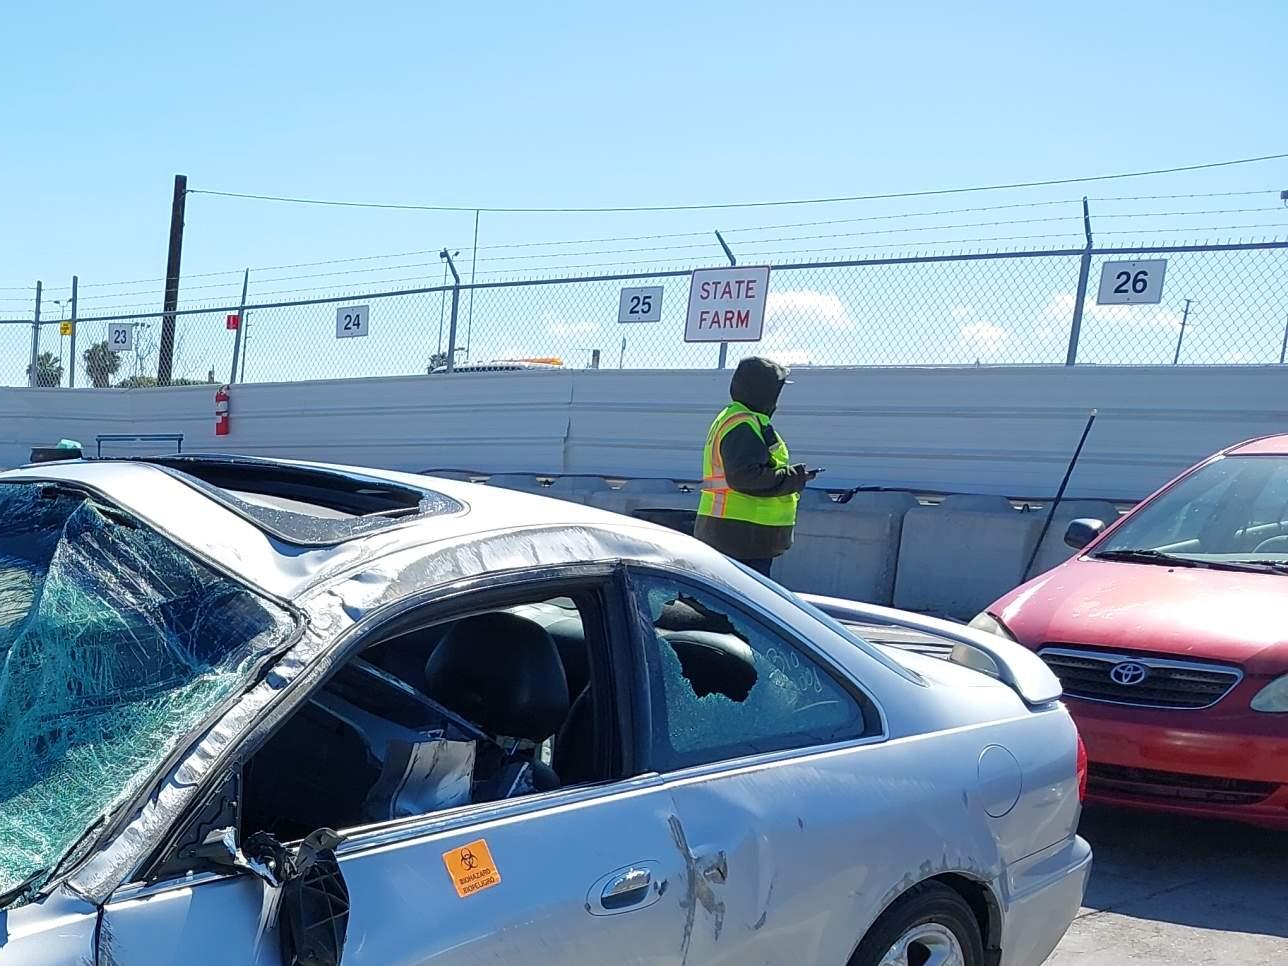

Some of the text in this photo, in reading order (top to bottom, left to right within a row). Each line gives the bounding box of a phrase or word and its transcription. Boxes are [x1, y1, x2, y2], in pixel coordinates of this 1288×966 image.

[699, 279, 757, 300] STATE
[1114, 270, 1149, 294] 26
[628, 295, 653, 315] 25
[343, 314, 361, 330] 24
[698, 309, 750, 329] FARM
[114, 329, 127, 344] 23
